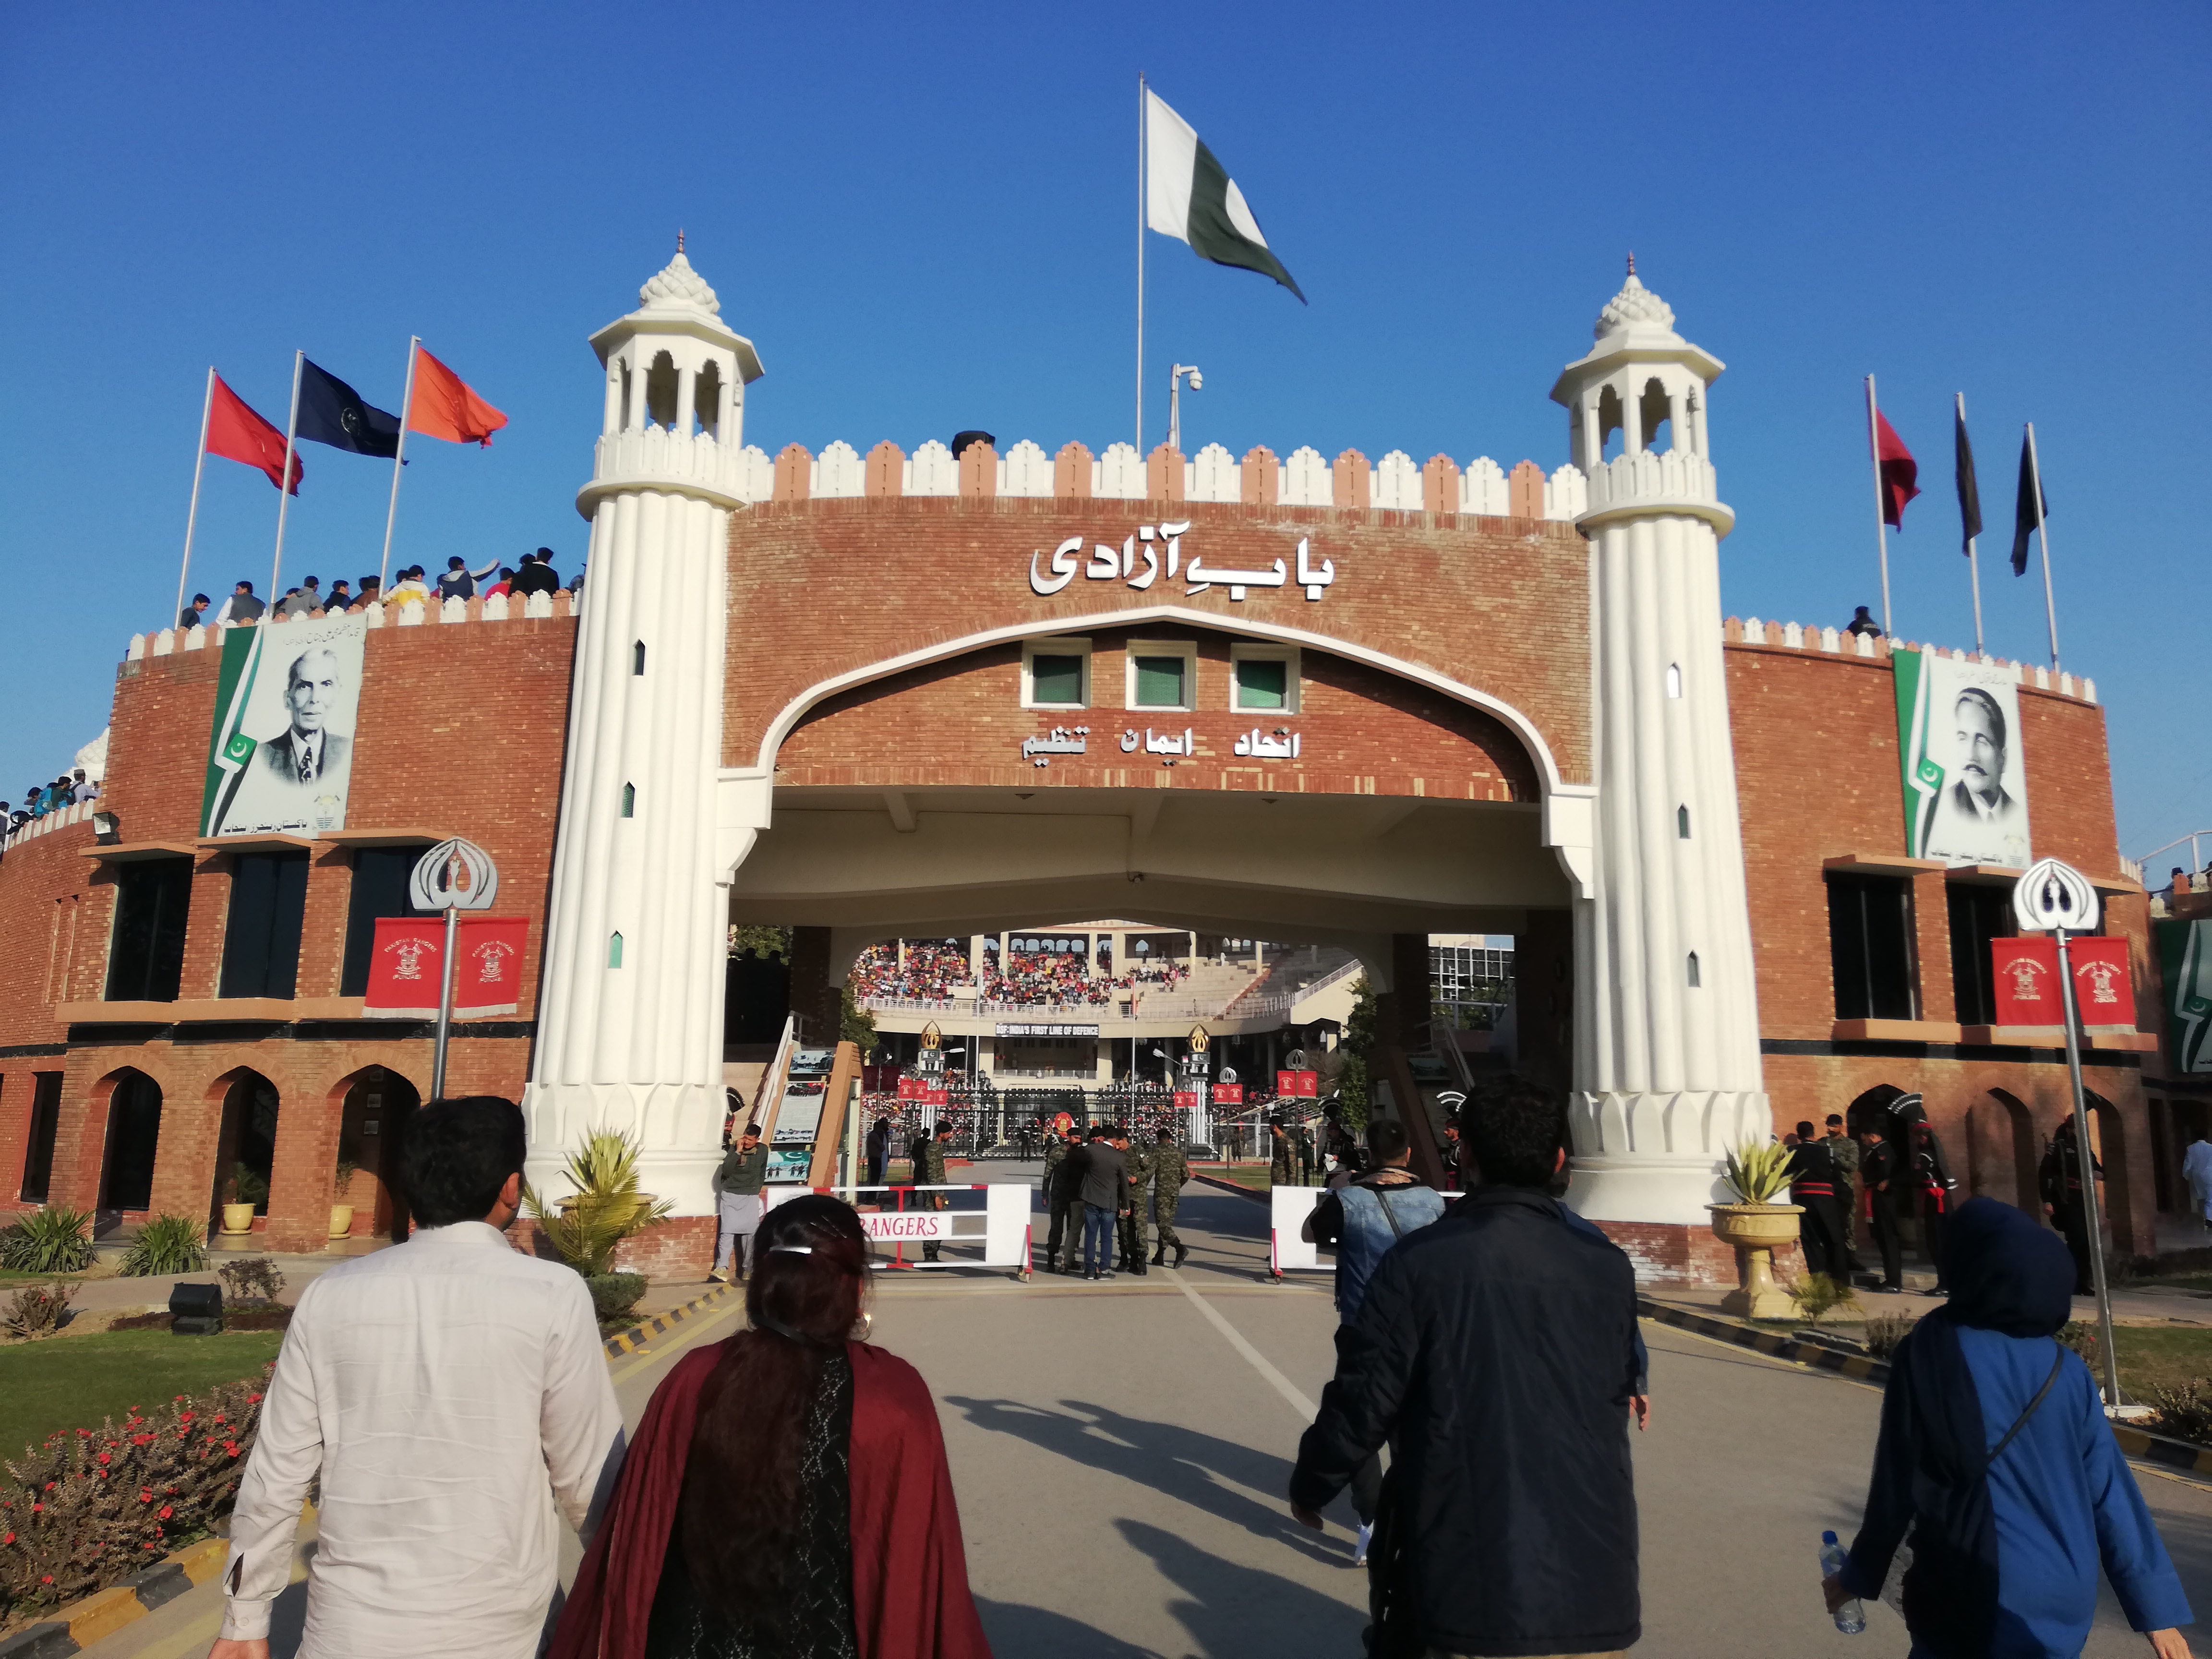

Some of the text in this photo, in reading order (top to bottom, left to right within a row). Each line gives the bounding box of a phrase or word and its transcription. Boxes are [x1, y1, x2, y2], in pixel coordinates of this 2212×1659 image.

[1030, 520, 1190, 595] آزادی
[1022, 725, 1300, 767] اتحاد ایمان تنظیم
[384, 938, 437, 952] PAKISTAN RANGERS
[1031, 1025, 1048, 1035] FIRST
[1049, 1025, 1063, 1035] LINE
[1064, 1026, 1072, 1035] OF
[1072, 1026, 1098, 1035] DEFENCE
